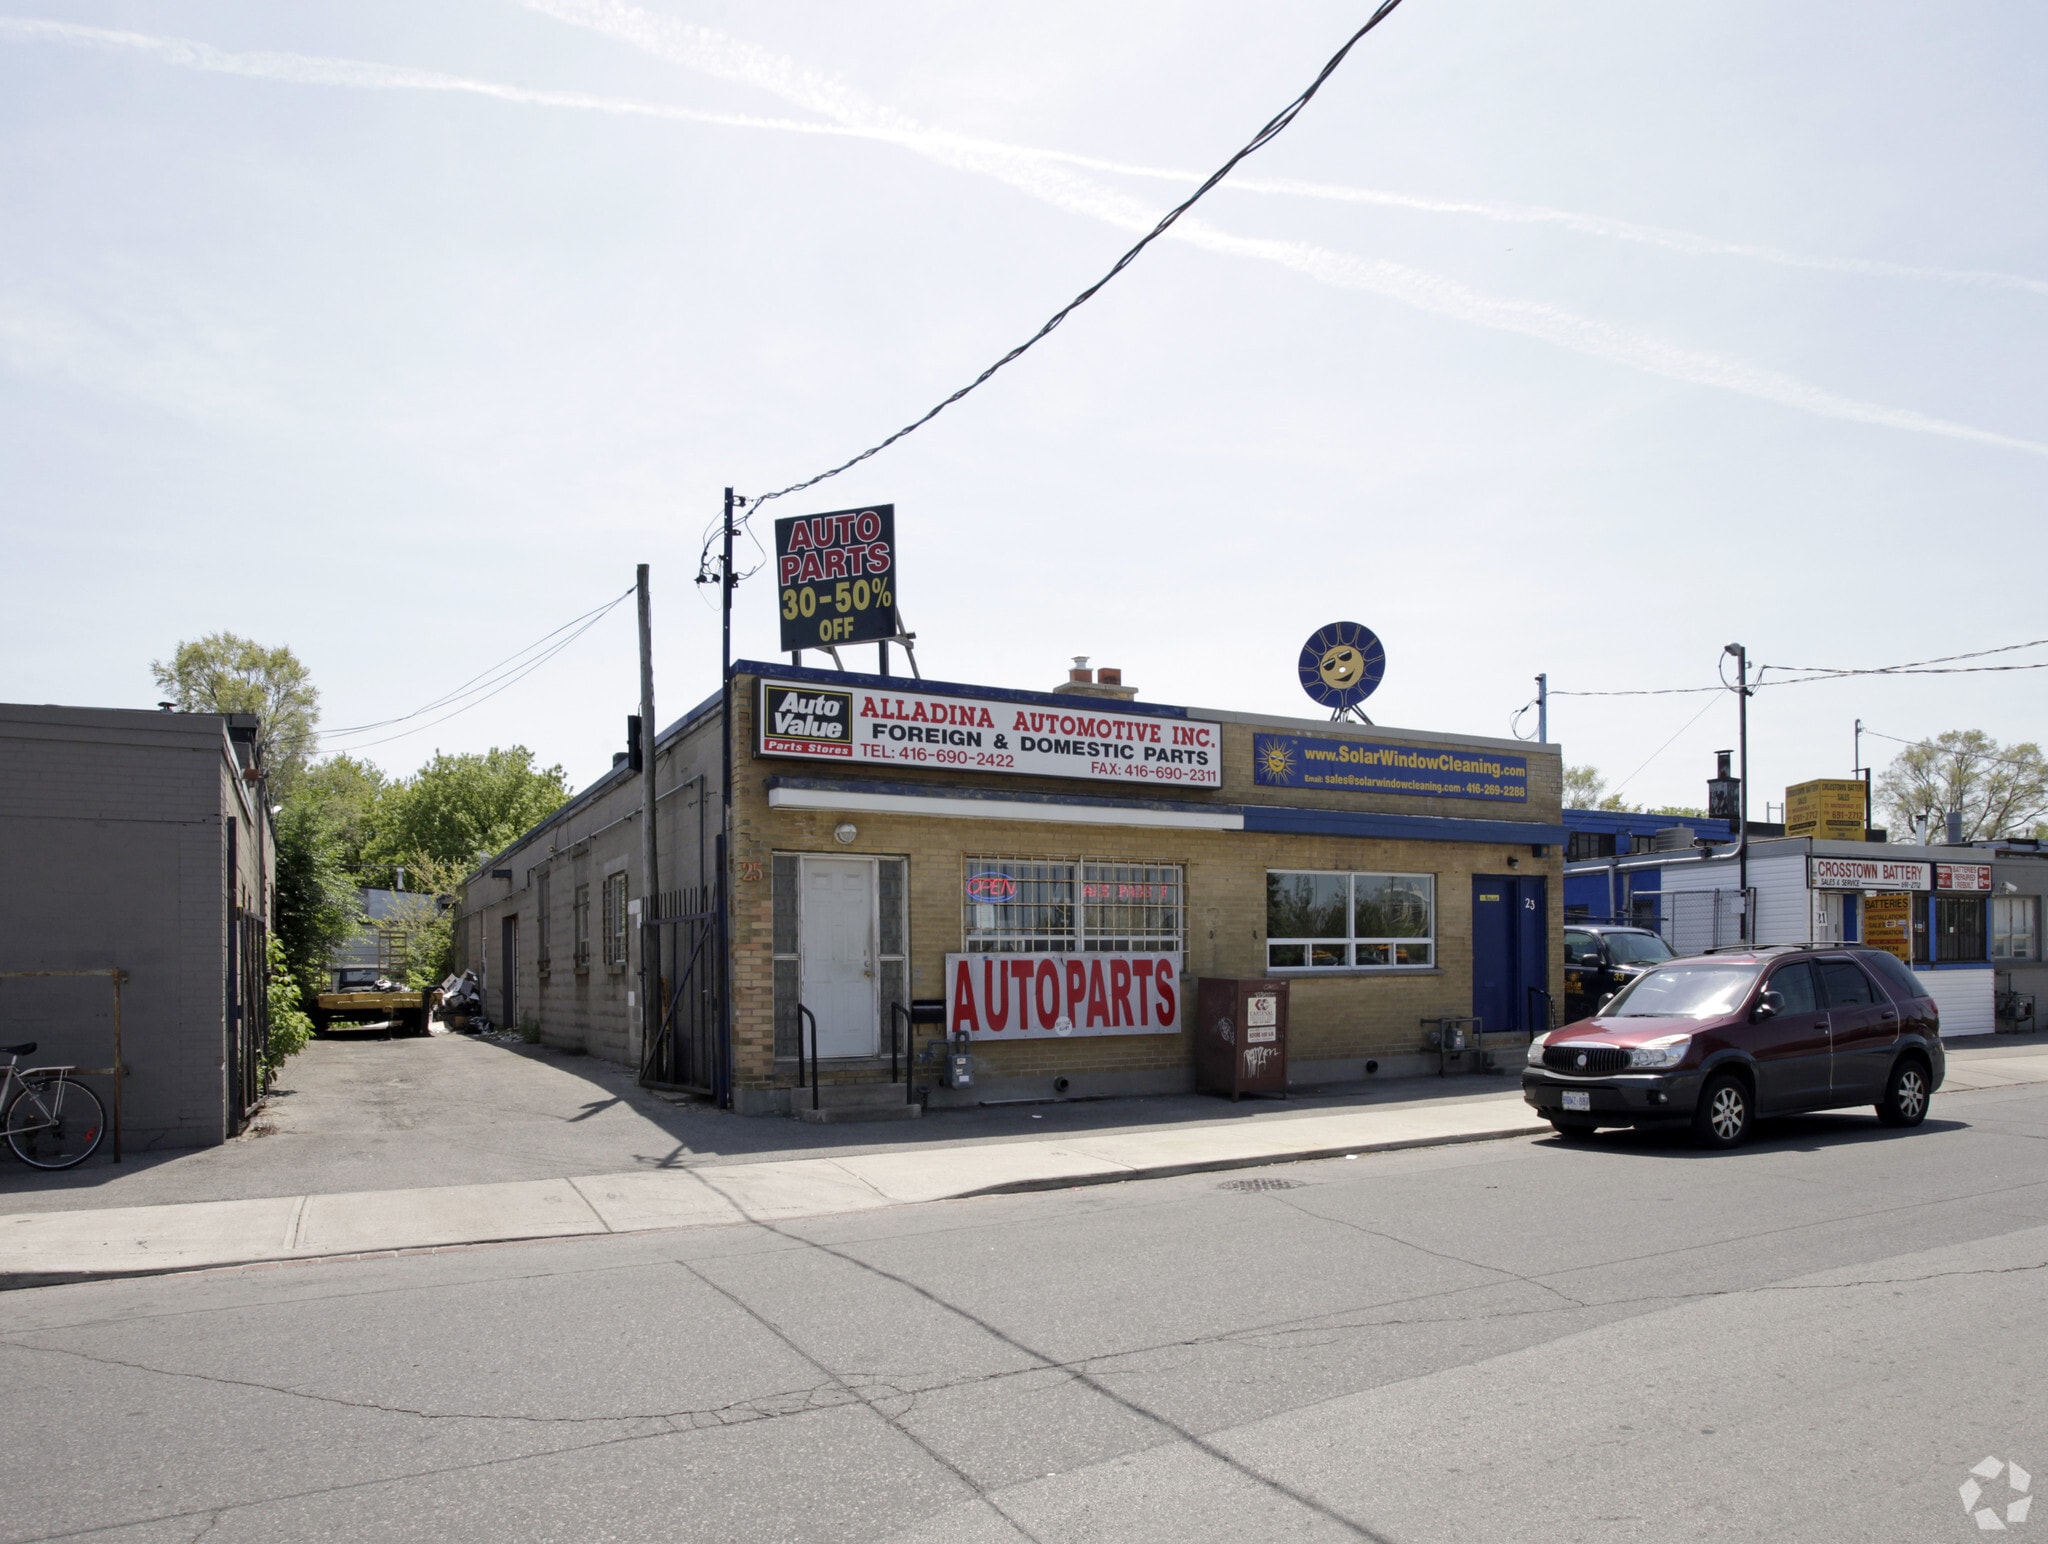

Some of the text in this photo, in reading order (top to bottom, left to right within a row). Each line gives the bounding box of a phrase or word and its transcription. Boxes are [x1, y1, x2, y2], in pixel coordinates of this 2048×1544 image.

[787, 511, 881, 552] AUTO
[780, 542, 891, 586] PARTS
[782, 577, 892, 620] 30-50%
[819, 617, 854, 642] OFF
[778, 691, 841, 717] Auto
[774, 711, 843, 738] Value
[860, 696, 1216, 748] ALLADINA AUTOMOTIVE INC.
[768, 741, 849, 755] Parts Stores
[860, 743, 1015, 769] TEL: 416-690-2422
[872, 723, 1208, 766] FOREIGN & DOMESTIC PARTS
[1091, 761, 1217, 783] FAX: 416-690-2311
[1304, 745, 1525, 778] www.SolarWindowCleaning.com
[1304, 774, 1525, 797] Email: sales@solarwindowcleaning.com 416-269-2288
[1837, 793, 1850, 801] SALES
[1832, 810, 1863, 820] 691-2712
[742, 862, 764, 881] 25
[1818, 861, 1923, 880] CROSSTOWN BATTERY
[967, 879, 1017, 895] OPEN
[1821, 878, 1836, 886] SALES
[1841, 878, 1860, 887] SERVICE
[1865, 898, 1909, 909] BATTERIES
[1613, 973, 1625, 981] 33
